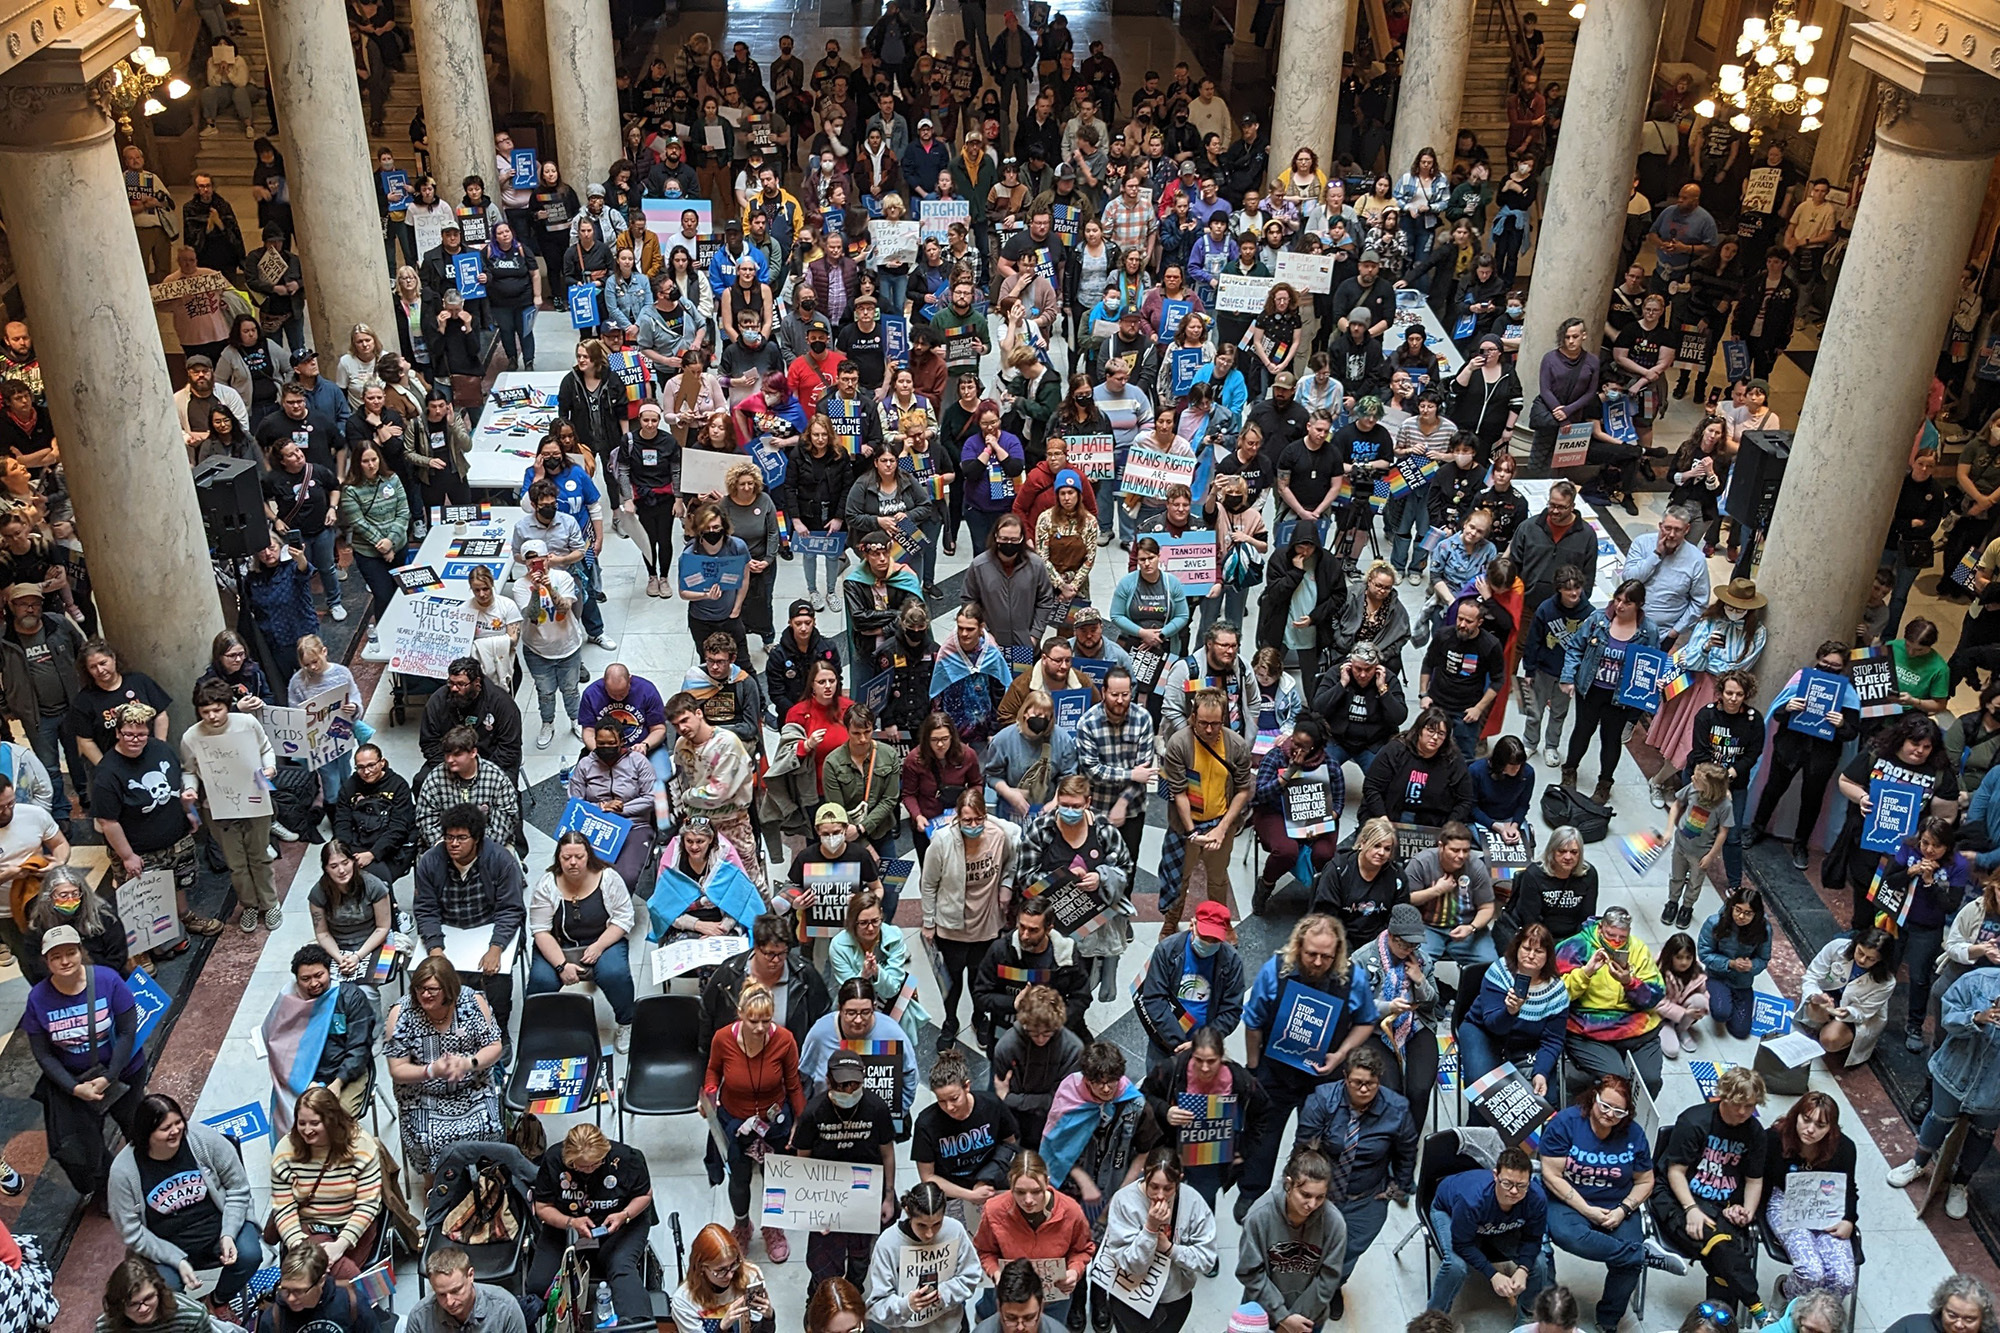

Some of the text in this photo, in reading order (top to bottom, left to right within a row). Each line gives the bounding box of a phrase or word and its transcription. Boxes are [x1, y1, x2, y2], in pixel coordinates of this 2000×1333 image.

[923, 203, 968, 216] RIGHTS
[1054, 223, 1077, 234] PEOPLE
[1680, 348, 1705, 360] HATE
[1082, 437, 1111, 453] HATE
[1558, 440, 1587, 450] TRANS
[1130, 449, 1194, 474] TRANS RIGHTS
[1558, 454, 1582, 462] YOUTH
[1151, 470, 1167, 480] ARE
[1398, 461, 1420, 490] PEOPLE
[1414, 470, 1426, 485] THE
[1122, 475, 1156, 495] HUMAN
[1170, 547, 1212, 556] TRANSITION
[1184, 560, 1206, 568] SAVES
[410, 600, 439, 618] THE
[418, 616, 459, 634] KILLS
[1638, 658, 1650, 666] STOP
[1637, 664, 1656, 675] ATTACKS
[1853, 662, 1889, 677] STOP THE
[1635, 675, 1650, 684] TRANS
[1854, 673, 1880, 686] SLATE
[1880, 672, 1891, 682] OF
[1811, 684, 1826, 692] STOP
[1809, 695, 1816, 703] ON
[1810, 690, 1833, 700] ATTACKS
[600, 703, 624, 716] PROUD
[1808, 701, 1825, 710] TRANS
[274, 729, 303, 741] KIDS
[1714, 726, 1731, 737] WILL
[1288, 783, 1323, 795] YOU CAN'T
[1290, 792, 1325, 803] LEGISLATE
[1883, 796, 1899, 804] STOP
[1291, 801, 1326, 812] AWAY OUR
[1882, 803, 1908, 813] ATTACKS
[1292, 809, 1326, 821] EXISTENCE
[1880, 815, 1899, 825] TRANS
[1491, 853, 1527, 862] STOP THE
[811, 881, 852, 895] STOP THE
[1054, 893, 1091, 919] AWAY OUR
[1061, 900, 1097, 927] EXISTENCE
[1297, 1003, 1314, 1014] STOP
[1757, 1005, 1782, 1016] ATTACKS
[1293, 1017, 1301, 1027] ON
[1295, 1011, 1324, 1027] ATTACKS
[1290, 1024, 1312, 1038] TRANS
[867, 1066, 894, 1077] CAN'T
[559, 1079, 583, 1087] THE
[1484, 1080, 1522, 1112] EXISTENCE
[1491, 1088, 1528, 1120] AWAY OUR
[1497, 1096, 1536, 1128] LEGISLATE
[1207, 1119, 1232, 1128] THE
[1507, 1103, 1543, 1136] YOU CAN'T
[939, 1123, 994, 1158] MORE
[1180, 1127, 1232, 1142] PEOPLE
[837, 1141, 854, 1149] too
[1707, 1135, 1744, 1153] TRANS
[767, 1160, 844, 1182] WE WILL
[1697, 1159, 1723, 1177] ARE
[152, 1174, 203, 1203] PROTECT
[160, 1186, 202, 1209] TRANS
[795, 1187, 848, 1207] OUTLIVE
[909, 1244, 950, 1264] TRANS
[1129, 1249, 1169, 1304] YOUTH
